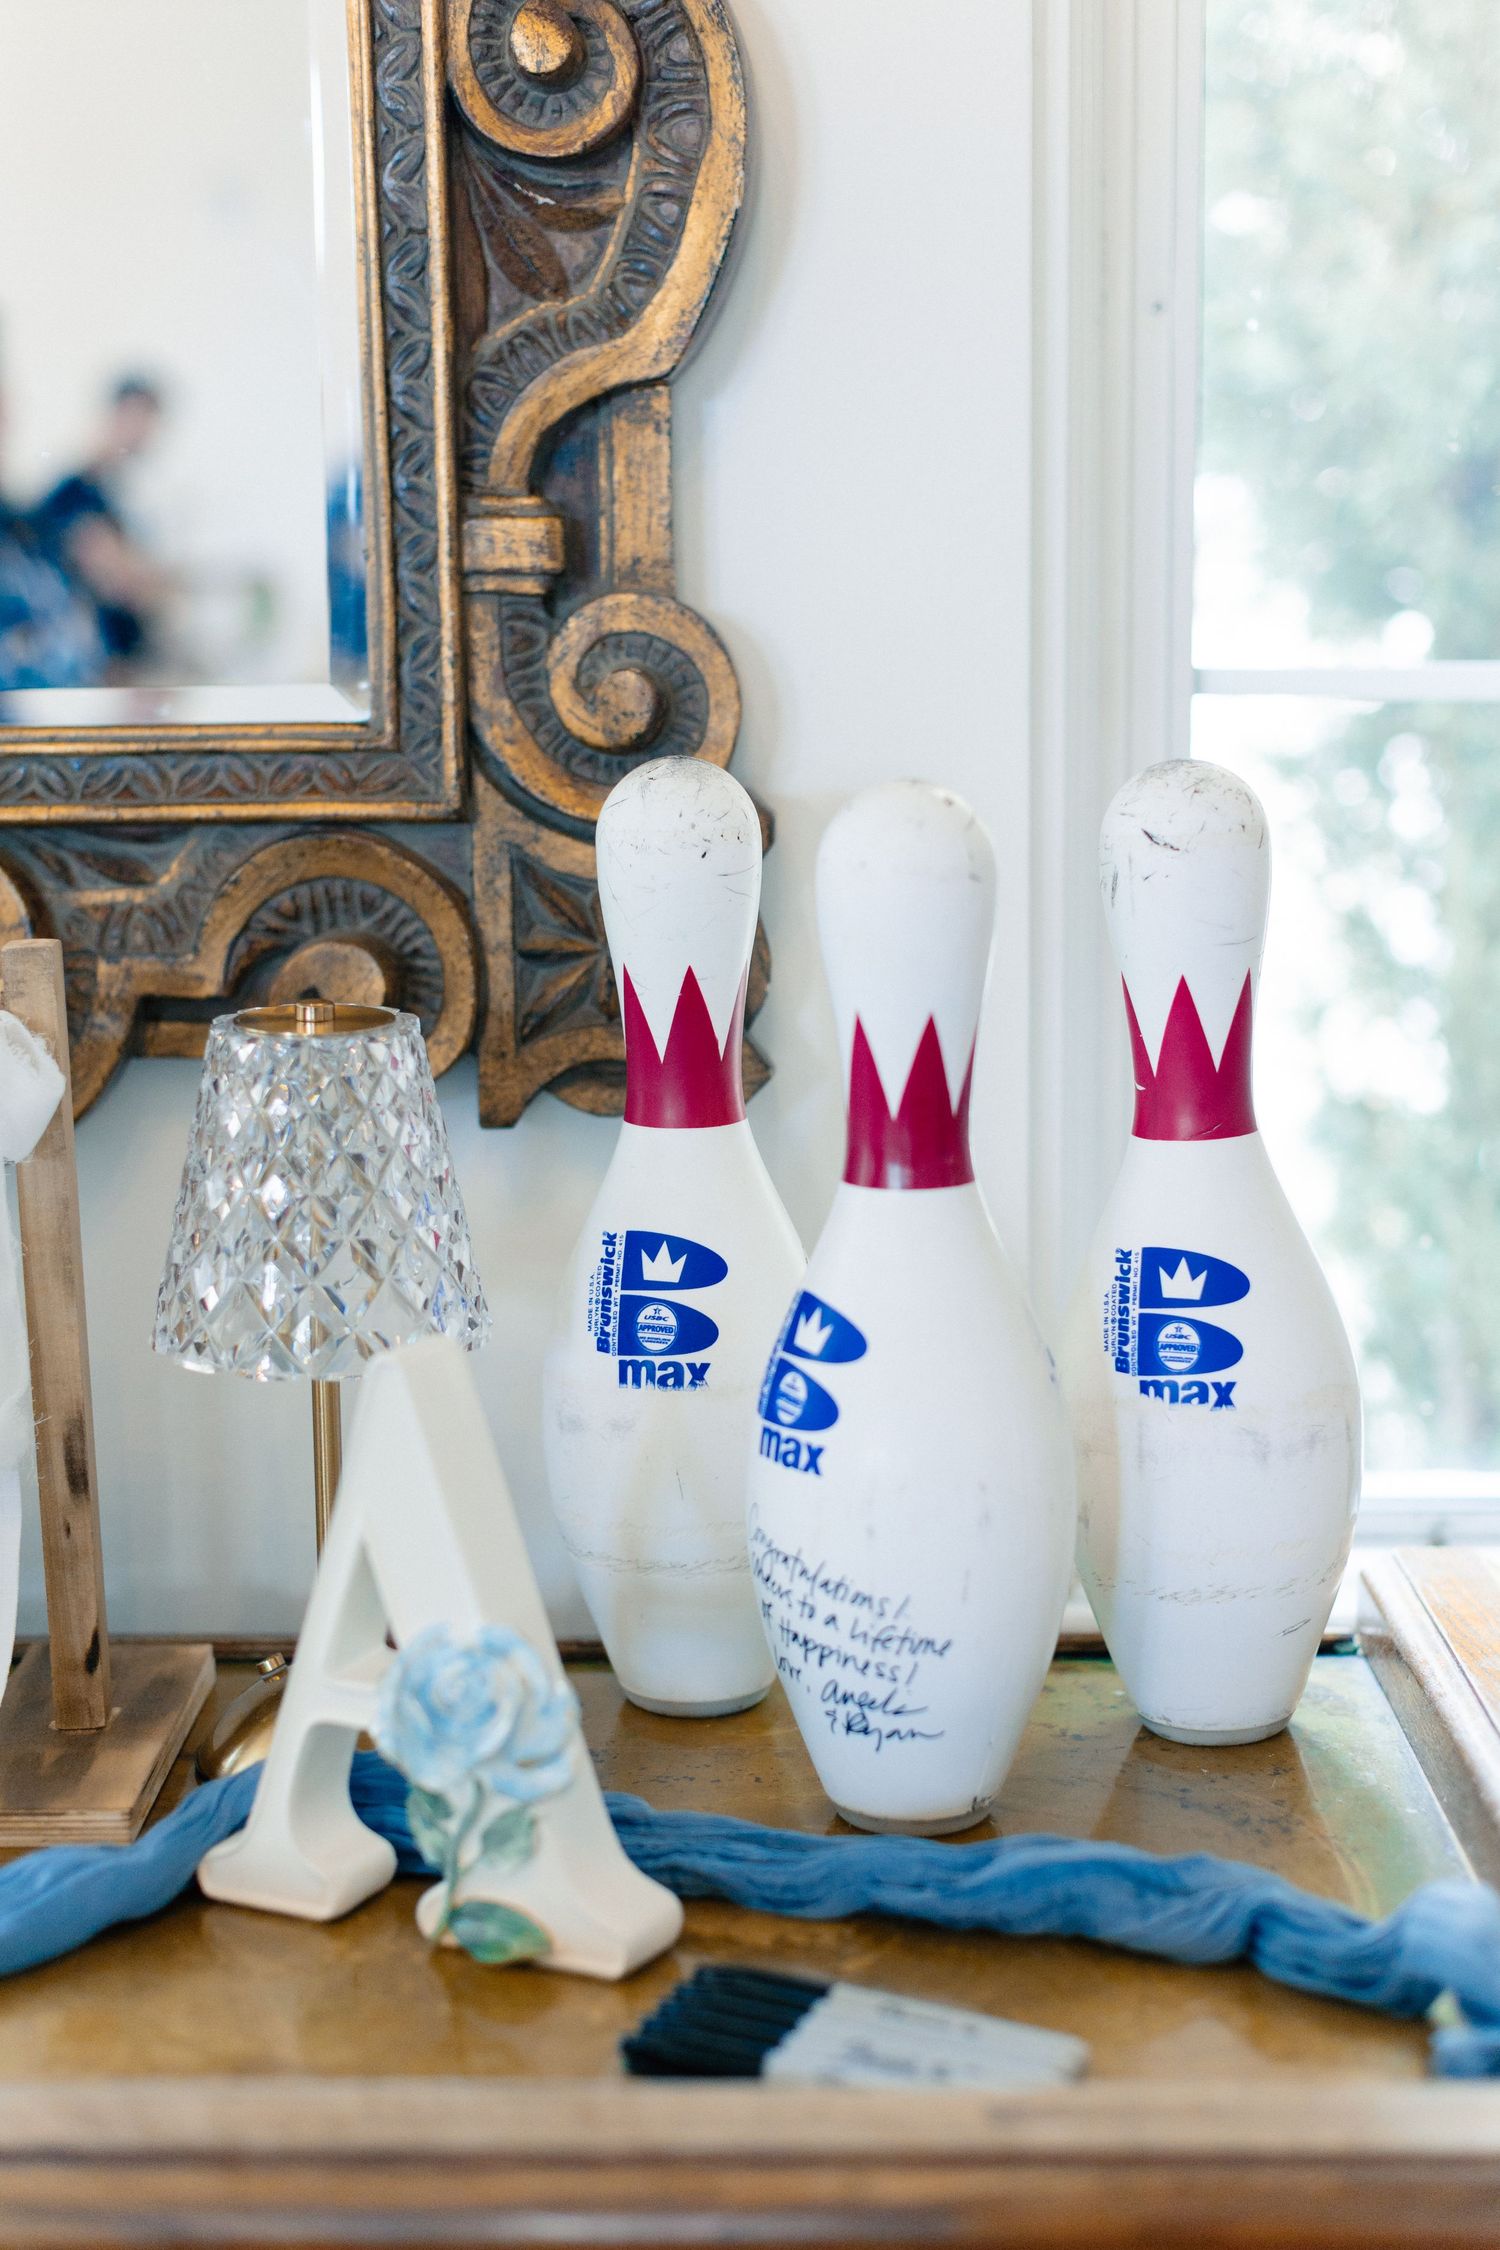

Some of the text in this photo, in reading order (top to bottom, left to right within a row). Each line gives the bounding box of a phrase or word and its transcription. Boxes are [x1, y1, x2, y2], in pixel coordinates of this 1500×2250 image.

[639, 1324, 674, 1334] APPROVED
[619, 1359, 711, 1392] max
[1139, 1379, 1237, 1411] max
[760, 1425, 825, 1476] max
[798, 1594, 816, 1620] to
[823, 1613, 840, 1632] a
[843, 1710, 945, 1752] Ryan
